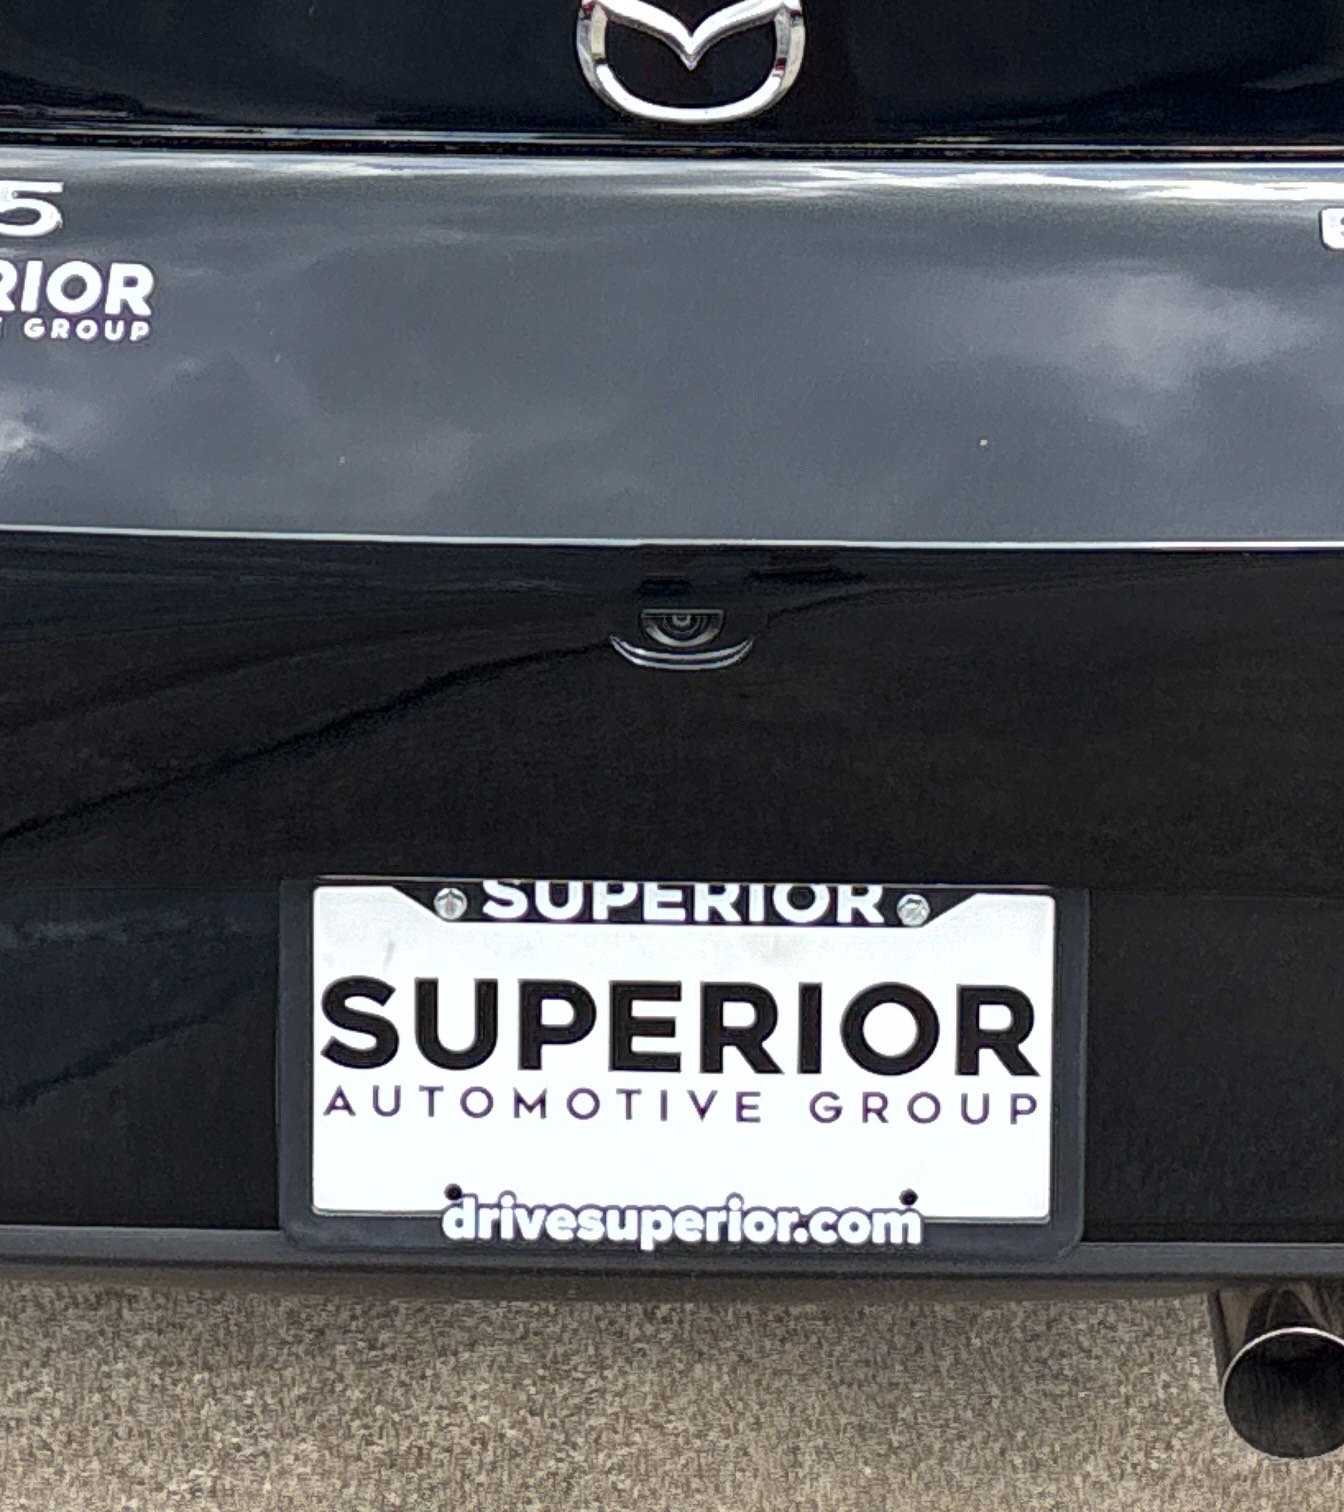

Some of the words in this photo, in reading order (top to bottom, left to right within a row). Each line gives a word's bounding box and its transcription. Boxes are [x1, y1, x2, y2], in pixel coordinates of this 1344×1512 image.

[23, 317, 150, 342] GROUP
[481, 879, 885, 923] SUPERIOR
[320, 975, 1040, 1078] SUPERIOR
[323, 1085, 762, 1123] AUTOMOTIVE
[810, 1093, 1038, 1125] GROUP
[441, 1192, 923, 1250] drivesuperior.com
